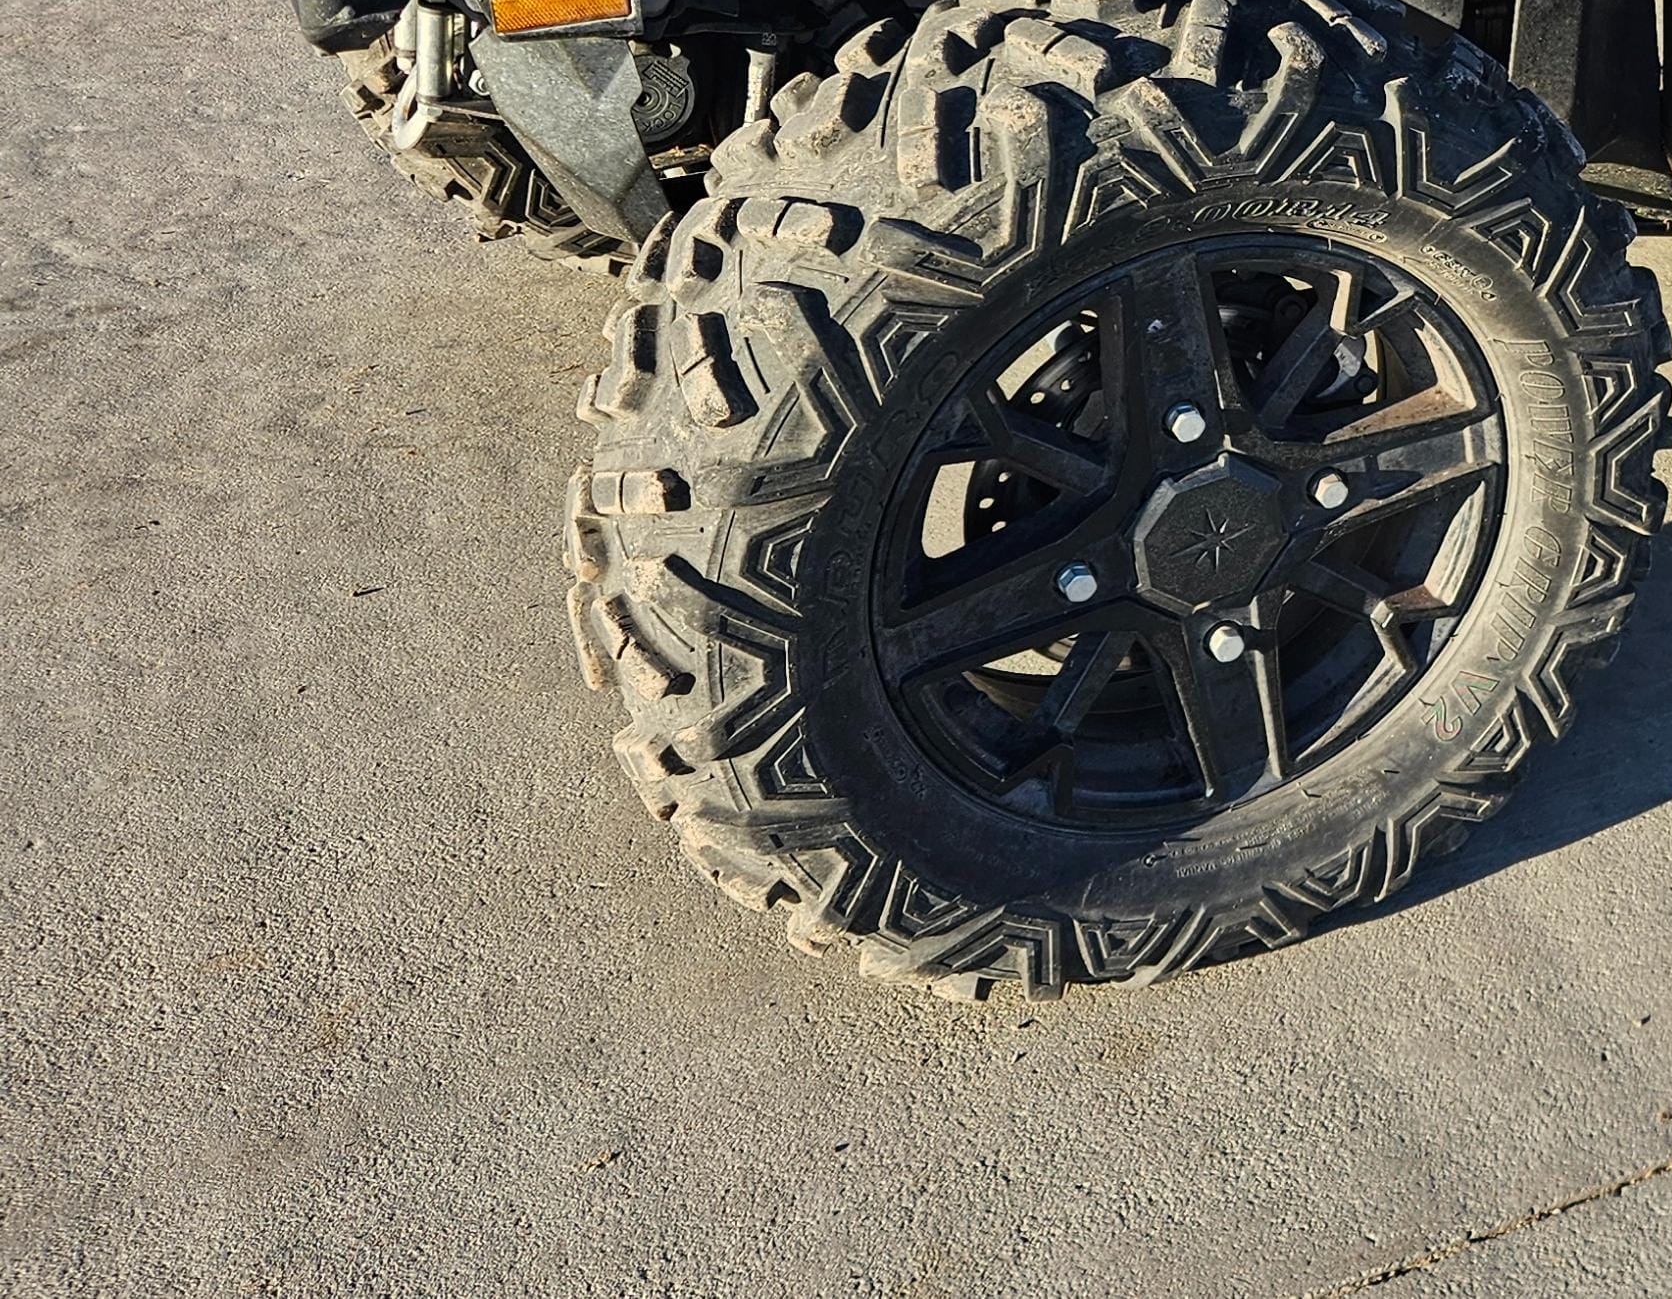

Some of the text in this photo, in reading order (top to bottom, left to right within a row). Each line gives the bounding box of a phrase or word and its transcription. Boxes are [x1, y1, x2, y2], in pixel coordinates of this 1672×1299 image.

[643, 101, 682, 132] LOCK
[1420, 338, 1576, 744] POWER GRIP V2
